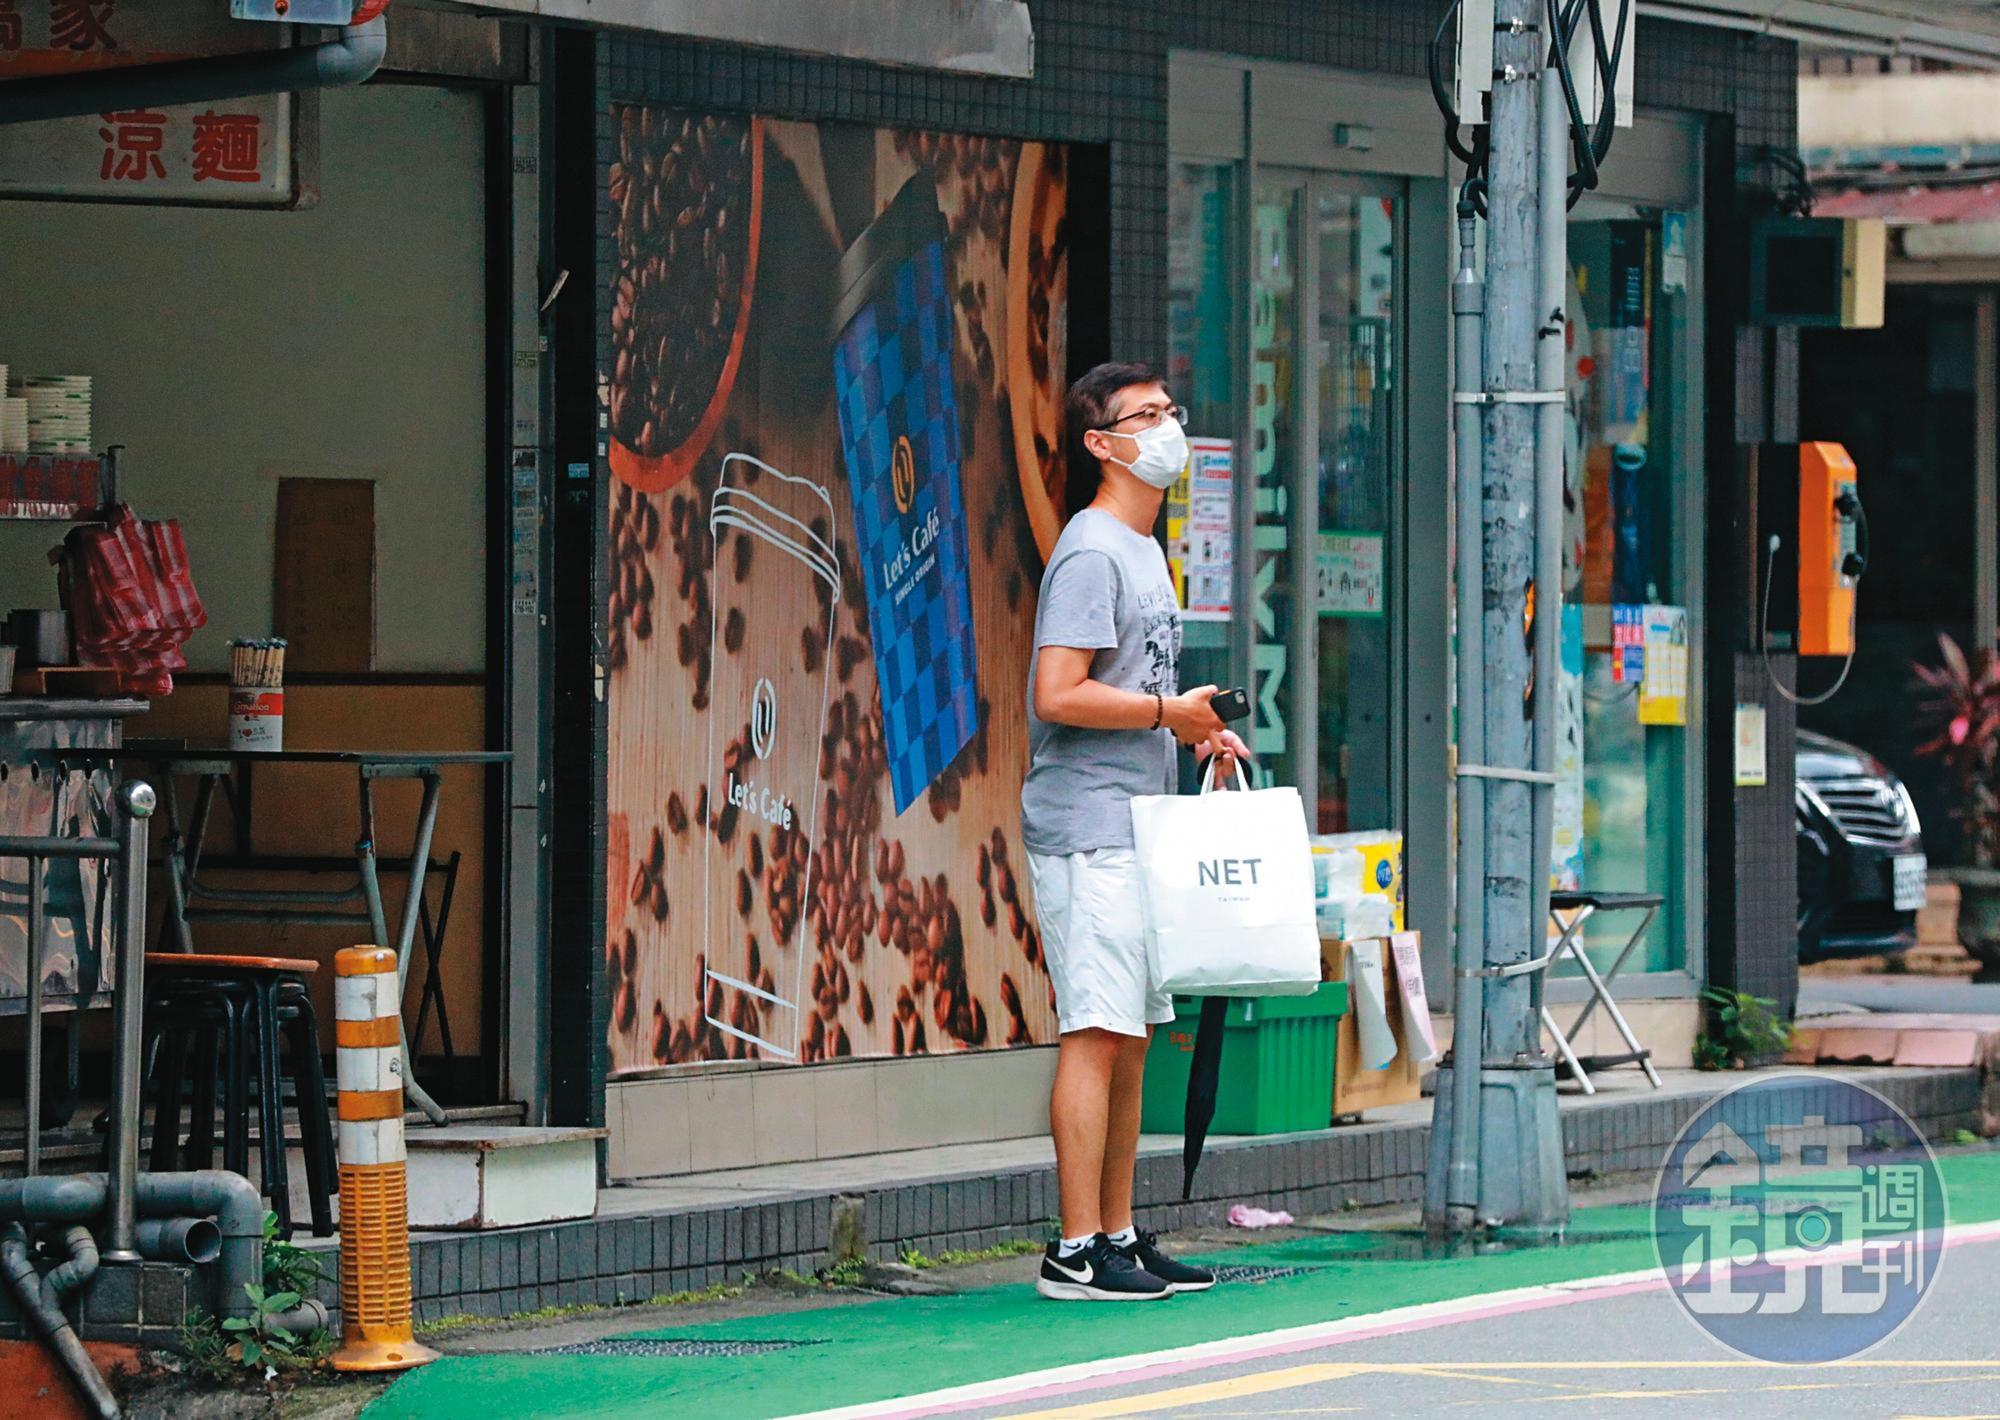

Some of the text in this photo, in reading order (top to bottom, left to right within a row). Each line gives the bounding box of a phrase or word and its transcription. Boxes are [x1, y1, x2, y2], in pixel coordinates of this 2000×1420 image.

[99, 107, 261, 183] 涼麵
[883, 507, 941, 590] Let's Café
[894, 553, 936, 607] SINGLE ORIGIN
[728, 772, 792, 831] Let's Café
[1198, 858, 1262, 887] NET
